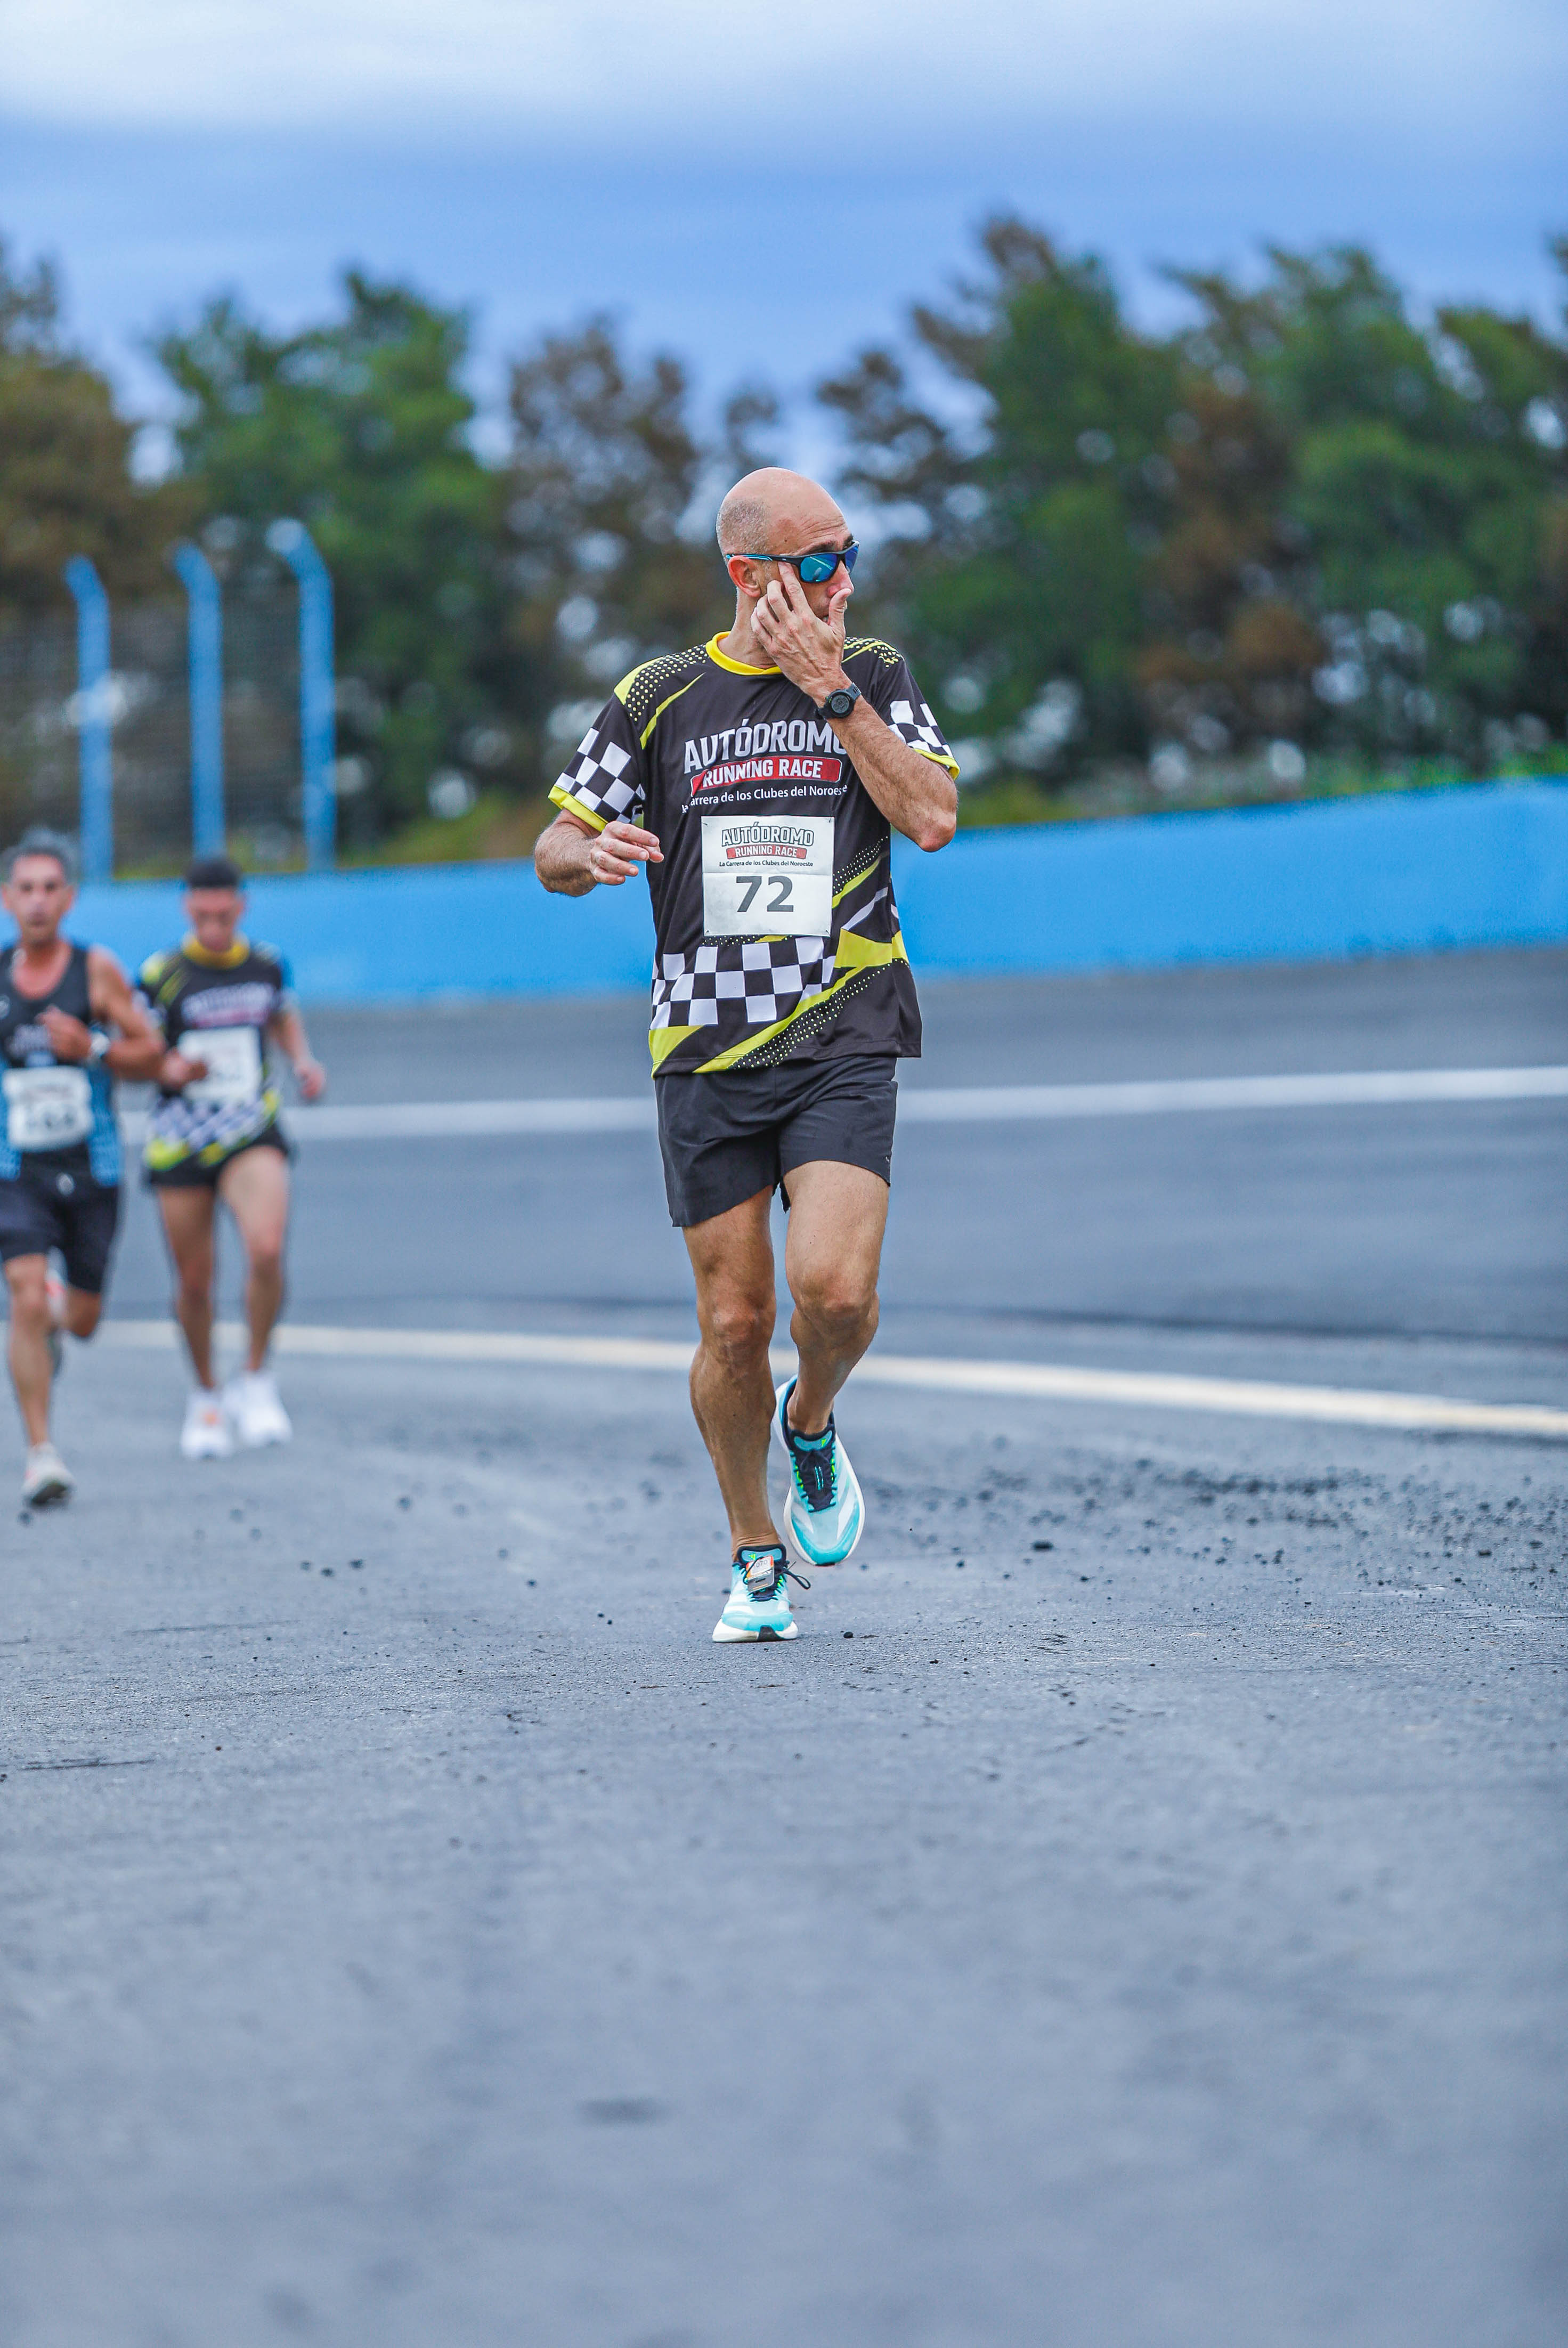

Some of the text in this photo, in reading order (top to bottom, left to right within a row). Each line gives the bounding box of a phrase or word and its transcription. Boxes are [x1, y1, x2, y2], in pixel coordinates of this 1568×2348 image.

[703, 759, 823, 787] RUNNING RACE
[689, 795, 719, 806] arrera
[720, 792, 734, 802] de
[736, 790, 752, 801] los
[753, 787, 789, 799] Clubes
[790, 785, 807, 797] del
[809, 784, 848, 796] Noroese
[721, 821, 815, 847] AUTÓDROMO
[735, 845, 798, 858] RUNNING RACE
[736, 875, 794, 913] 72
